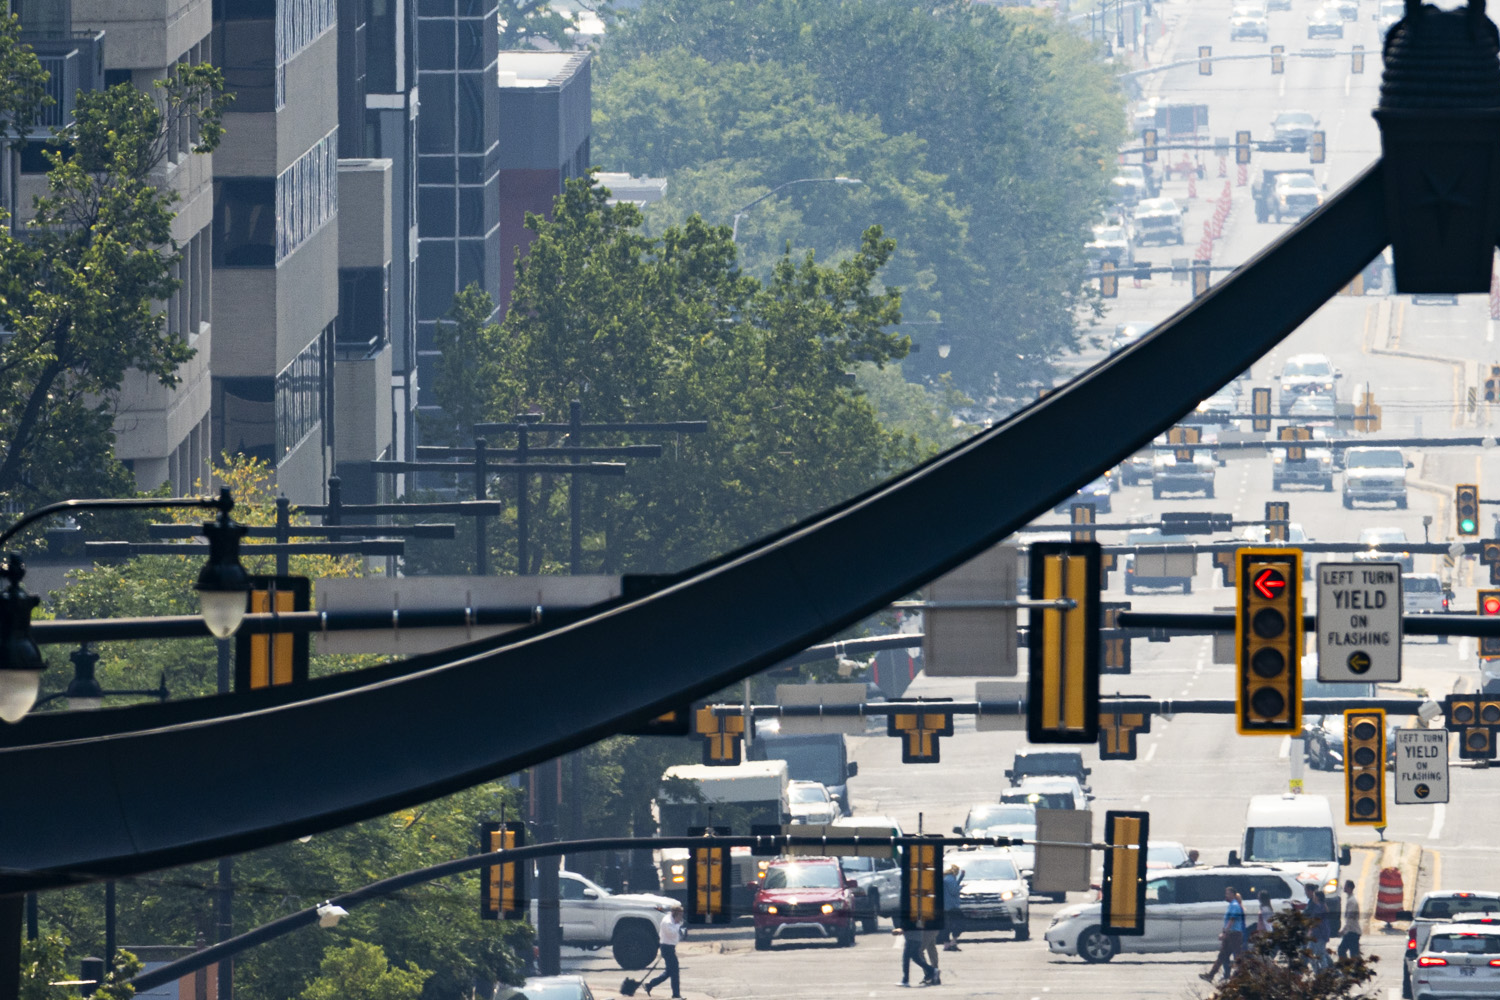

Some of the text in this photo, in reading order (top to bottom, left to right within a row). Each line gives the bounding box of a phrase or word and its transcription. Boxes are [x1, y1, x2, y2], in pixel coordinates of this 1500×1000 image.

[1323, 571, 1395, 585] LEFT TURN
[1333, 590, 1387, 609] YIELD
[1350, 615, 1367, 628] ON
[1328, 632, 1390, 645] FLASHING
[1399, 734, 1443, 743] LEFT TURN
[1405, 746, 1438, 758] YIELD
[1416, 761, 1428, 770] ON
[1402, 772, 1441, 781] FLASHING
